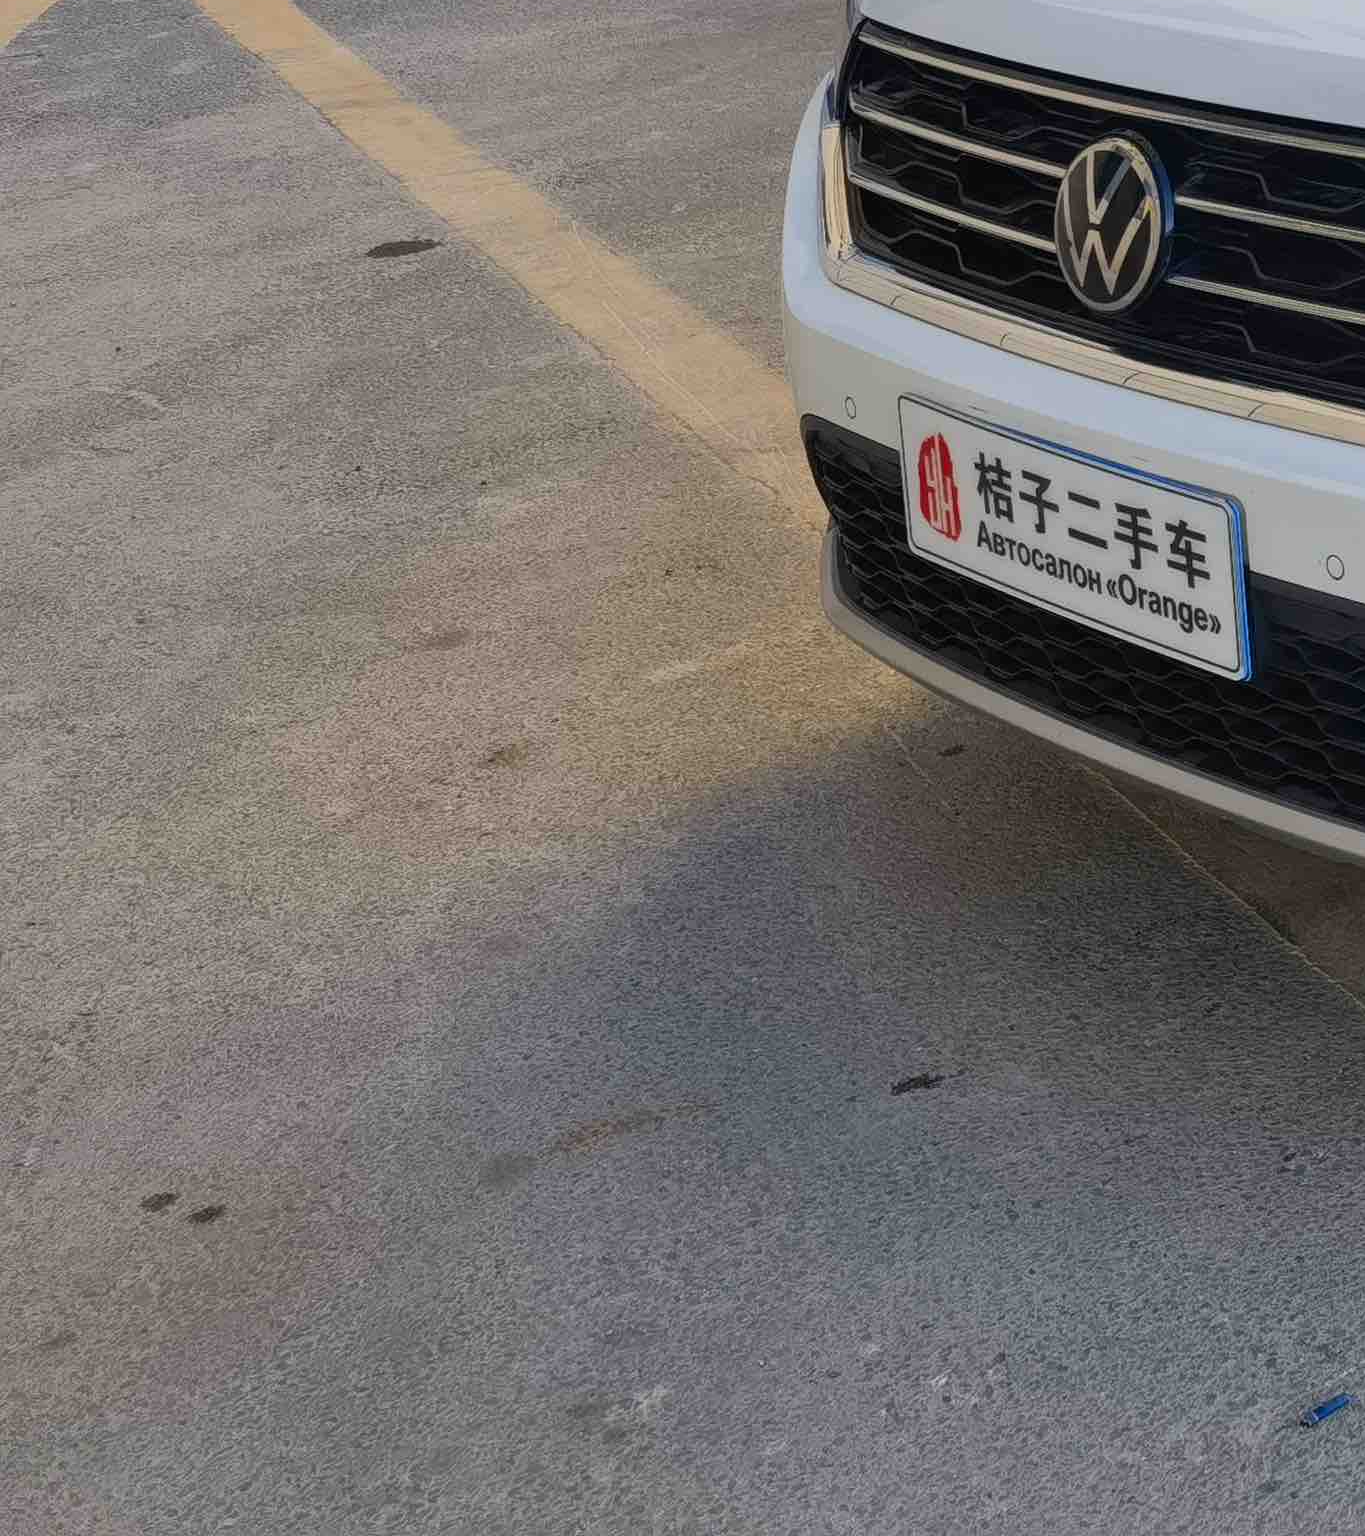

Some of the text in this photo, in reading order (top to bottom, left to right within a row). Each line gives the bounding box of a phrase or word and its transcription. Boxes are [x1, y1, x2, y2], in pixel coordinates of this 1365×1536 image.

[974, 451, 1211, 589] 桔子二手车
[977, 519, 1222, 637] Автосалон «Orange»
